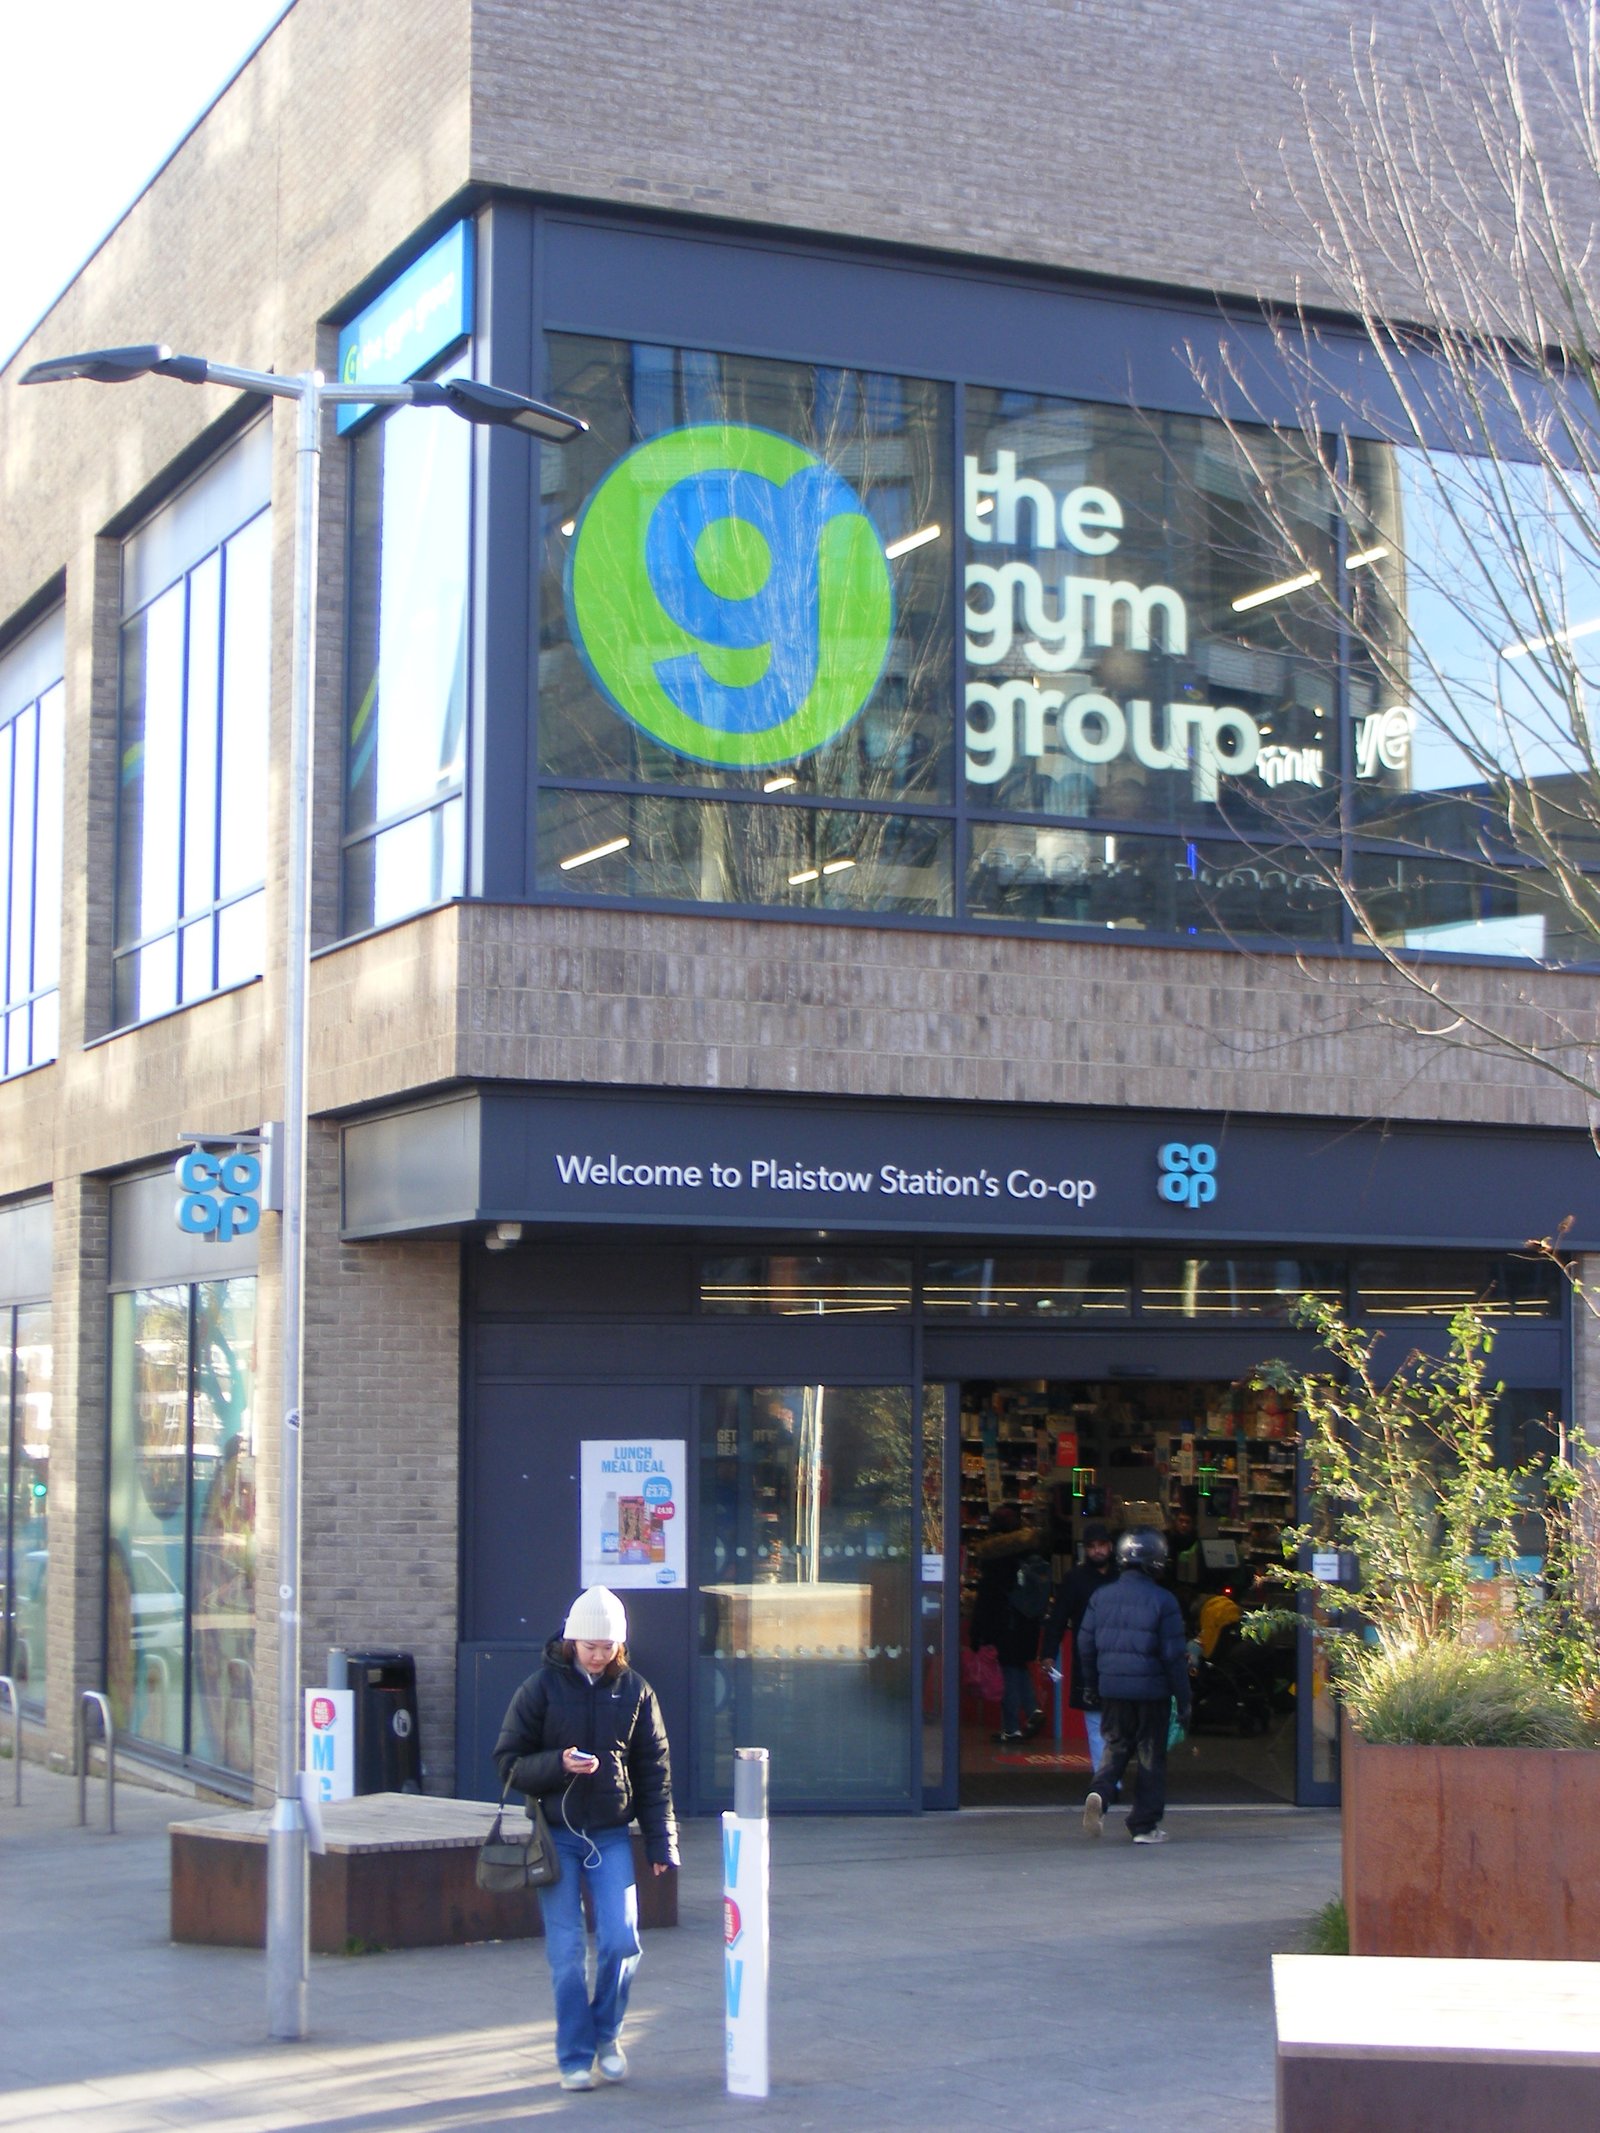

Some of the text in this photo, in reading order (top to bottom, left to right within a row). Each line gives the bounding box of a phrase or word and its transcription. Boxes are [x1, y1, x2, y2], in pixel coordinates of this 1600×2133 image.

[964, 450, 1124, 556] the
[964, 561, 1187, 672] gym
[964, 679, 1262, 803] group
[556, 1153, 702, 1187] Welcome
[709, 1162, 743, 1189] to
[750, 1159, 873, 1193] Plaistow
[1006, 1169, 1097, 1208] Co-op
[601, 1460, 666, 1473] MEAL DEAL
[613, 1446, 653, 1459] LUNCH
